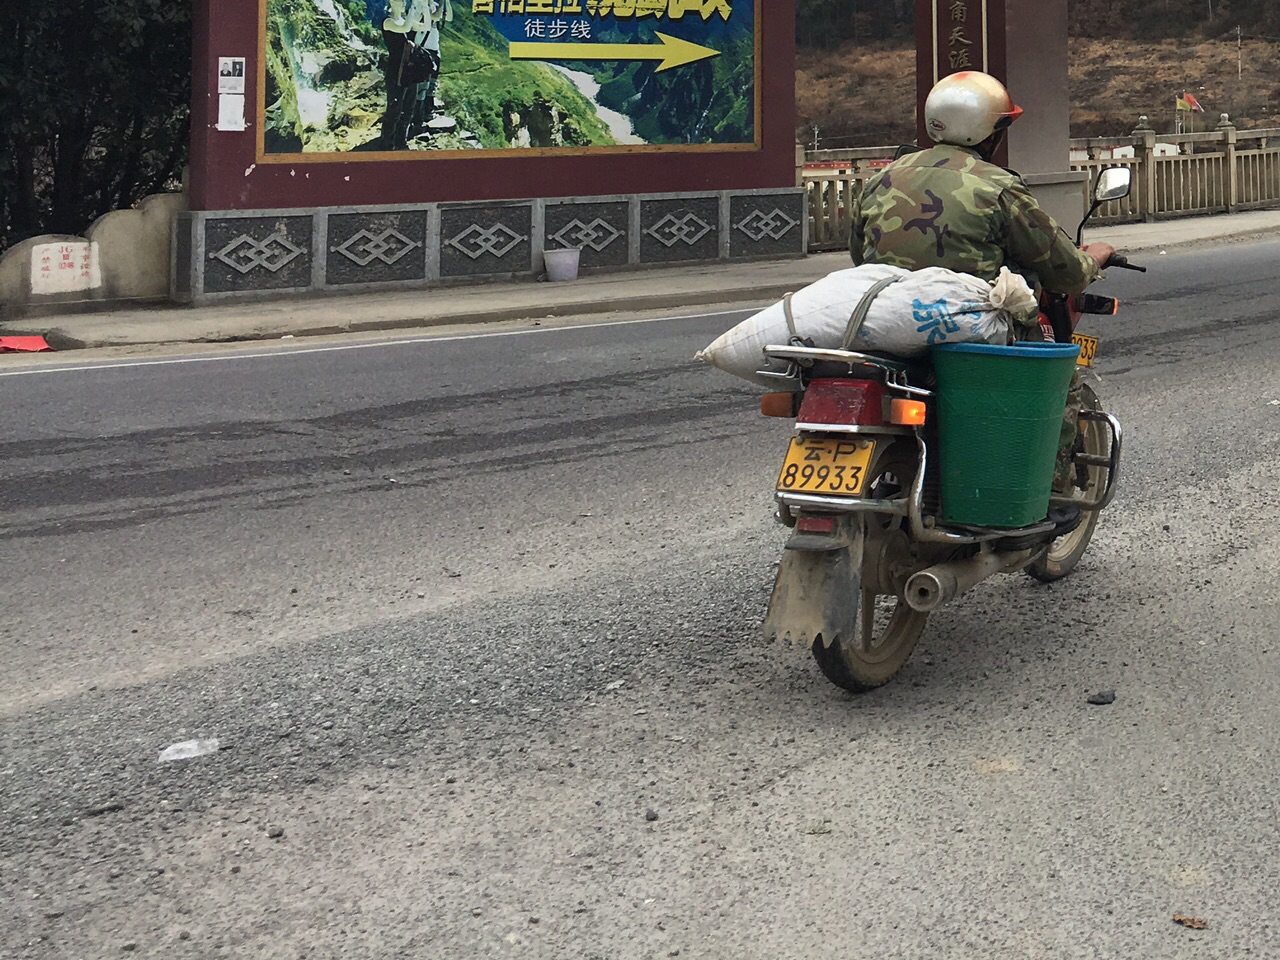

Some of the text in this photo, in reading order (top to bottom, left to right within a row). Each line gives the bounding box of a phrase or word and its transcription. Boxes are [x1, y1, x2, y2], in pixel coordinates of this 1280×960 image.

[524, 17, 592, 39] 徒步线
[782, 462, 862, 491] 89933
